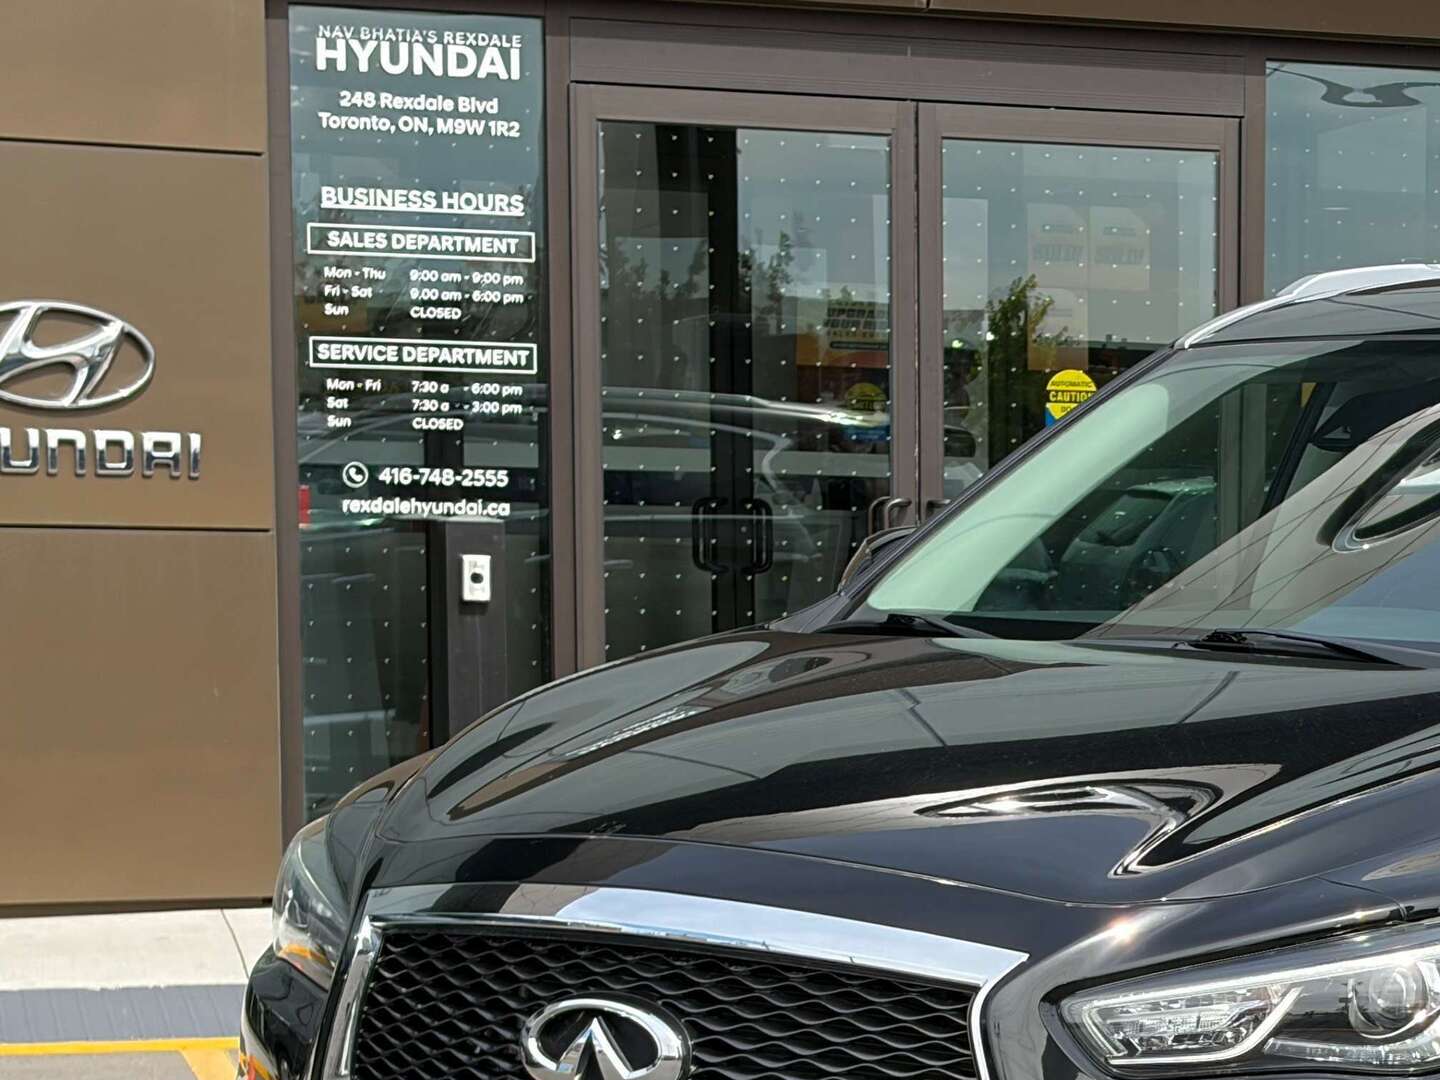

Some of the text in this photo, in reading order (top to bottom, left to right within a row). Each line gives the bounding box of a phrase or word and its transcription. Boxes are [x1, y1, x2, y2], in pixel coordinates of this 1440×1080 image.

[319, 25, 522, 48] NAV BHATIA'S REXDALE
[316, 37, 521, 80] HYUNDAI
[339, 90, 499, 114] 248 Rexdale Blvd
[318, 112, 521, 138] Toronto, ON, M9W 1R2
[321, 186, 525, 214] BUSINESS HOURS
[327, 231, 520, 254] SALES DEPARTMENT
[324, 266, 352, 279] Mon
[362, 267, 386, 280] Thu
[409, 269, 439, 283] 9:00
[441, 272, 462, 283] am
[472, 271, 501, 285] 9:00
[502, 274, 524, 288] pm
[324, 284, 340, 297] Fri
[351, 285, 373, 298] Sat
[441, 291, 462, 301] am
[472, 289, 501, 303] 6:00
[502, 293, 524, 306] pm
[324, 303, 462, 320] Sun CLOSED
[317, 343, 530, 367] SERVICE DEPARTMENT
[326, 378, 355, 391] Mon
[365, 378, 381, 392] Fri
[411, 380, 438, 394] 7:30
[471, 382, 500, 396] 6:00
[502, 386, 523, 399] pm
[326, 397, 349, 409] Sat
[411, 399, 438, 412] 7:30
[471, 400, 500, 414] 3:00
[502, 403, 523, 417] pm
[327, 415, 464, 431] Sun CLOSED
[378, 467, 509, 488] 416-748-2555
[342, 497, 511, 518] rexdalehyundai.ca
